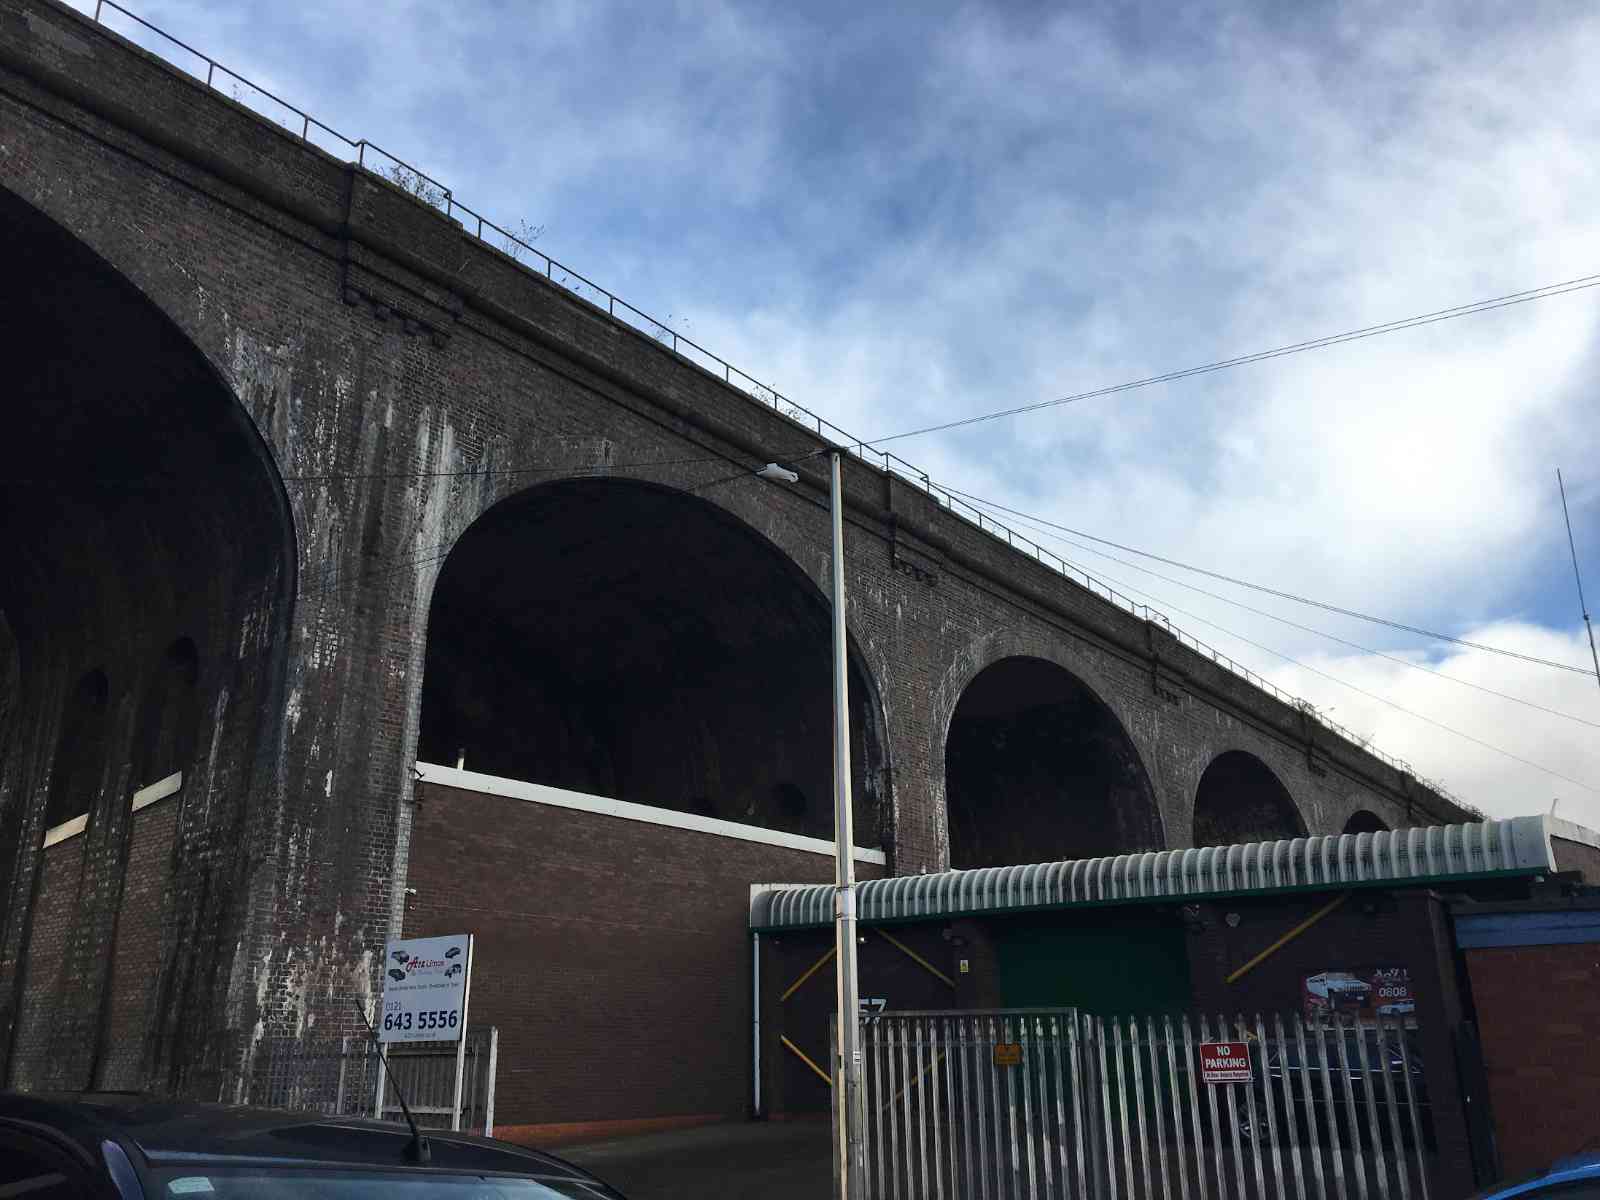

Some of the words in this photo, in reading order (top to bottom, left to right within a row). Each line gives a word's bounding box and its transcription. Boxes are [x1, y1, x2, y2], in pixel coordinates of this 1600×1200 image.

[384, 1012, 412, 1031] 643
[418, 1010, 458, 1030] 5556
[1216, 1046, 1231, 1056] NO
[1205, 1058, 1246, 1069] PARKING
